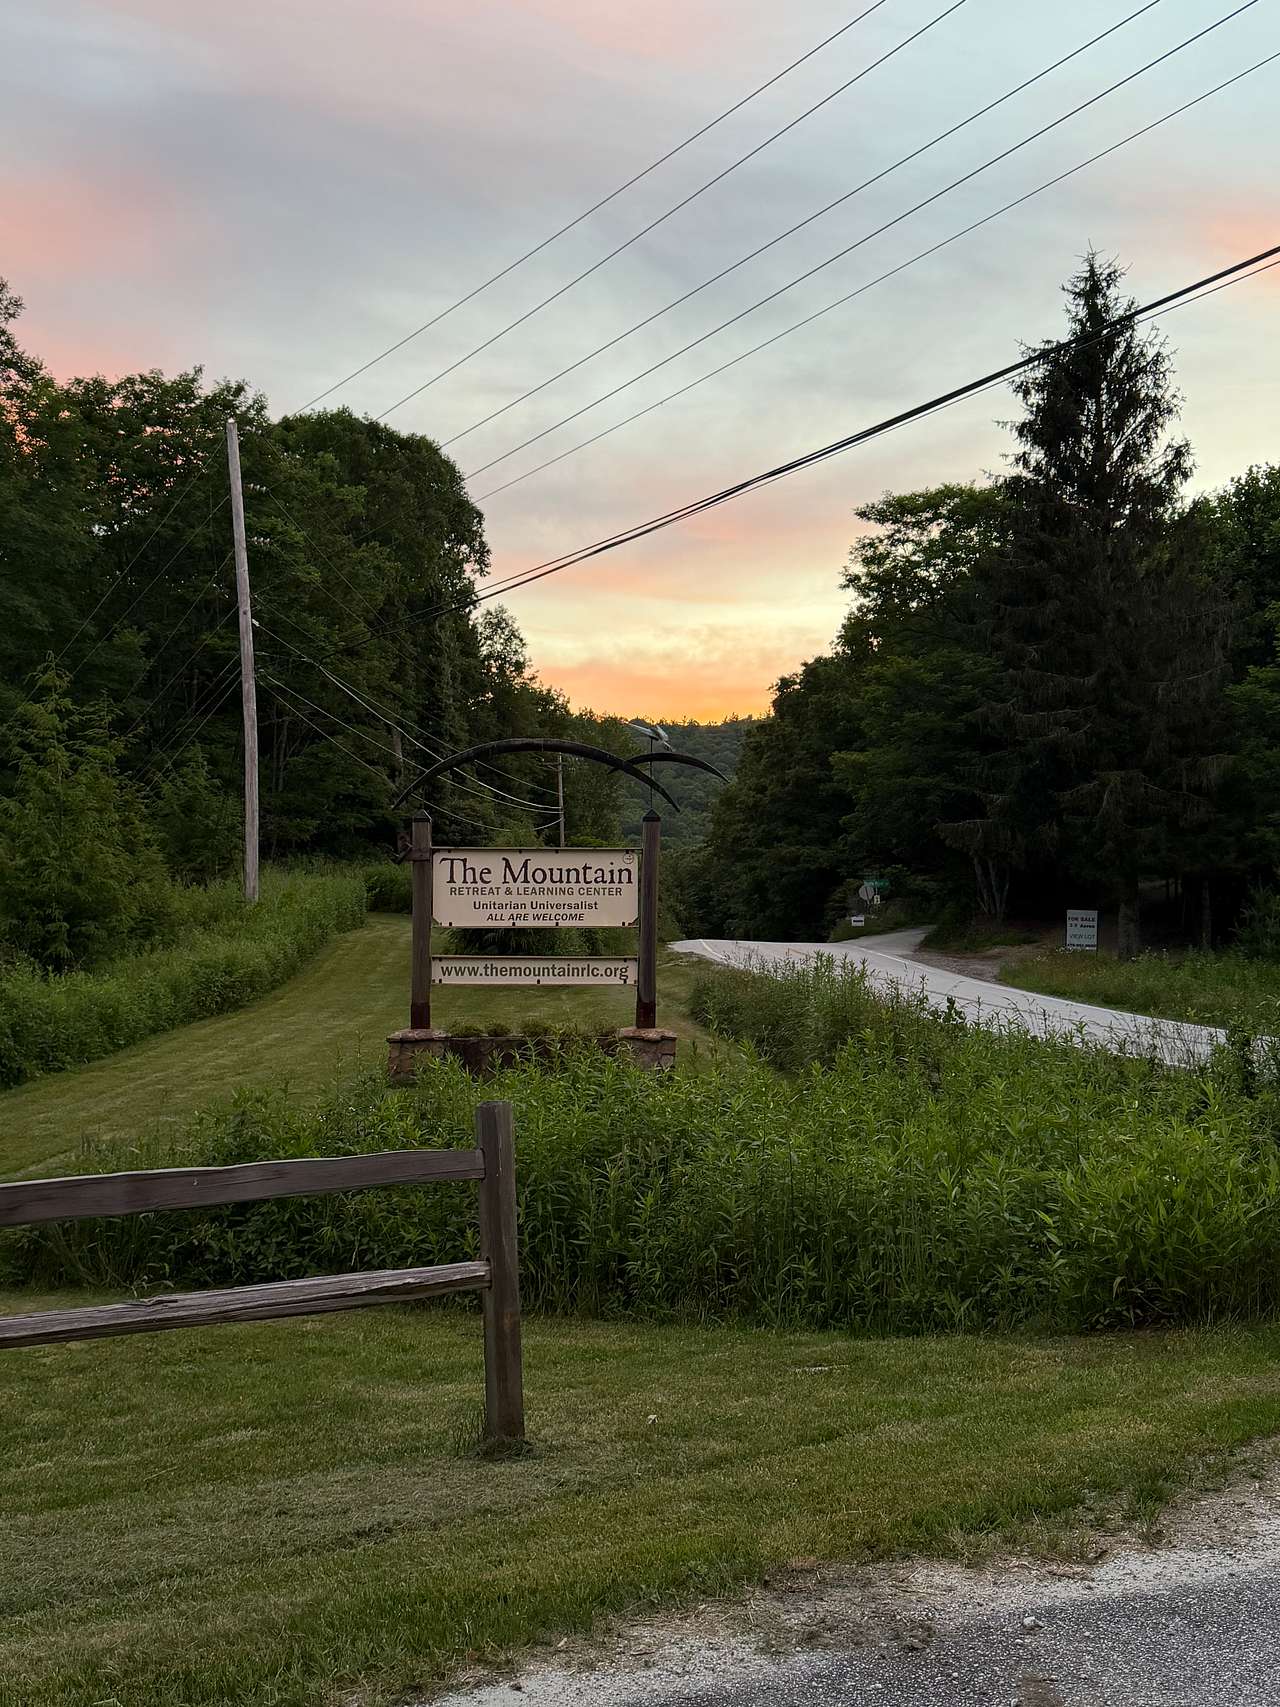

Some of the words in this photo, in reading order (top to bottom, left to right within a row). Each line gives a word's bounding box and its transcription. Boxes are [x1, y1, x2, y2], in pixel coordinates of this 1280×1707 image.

[439, 857, 492, 885] The
[502, 857, 633, 885] Mountain
[450, 887, 501, 896] RETREAT
[505, 887, 513, 896] &
[516, 887, 574, 896] LEARNING
[578, 887, 622, 896] CENTER
[473, 901, 527, 910] Unitarian
[530, 901, 598, 910] Universalist
[487, 913, 506, 921] ALL
[507, 913, 529, 921] ARE
[532, 913, 585, 921] WELCOME
[441, 963, 629, 980] www.themountainrlc.org
